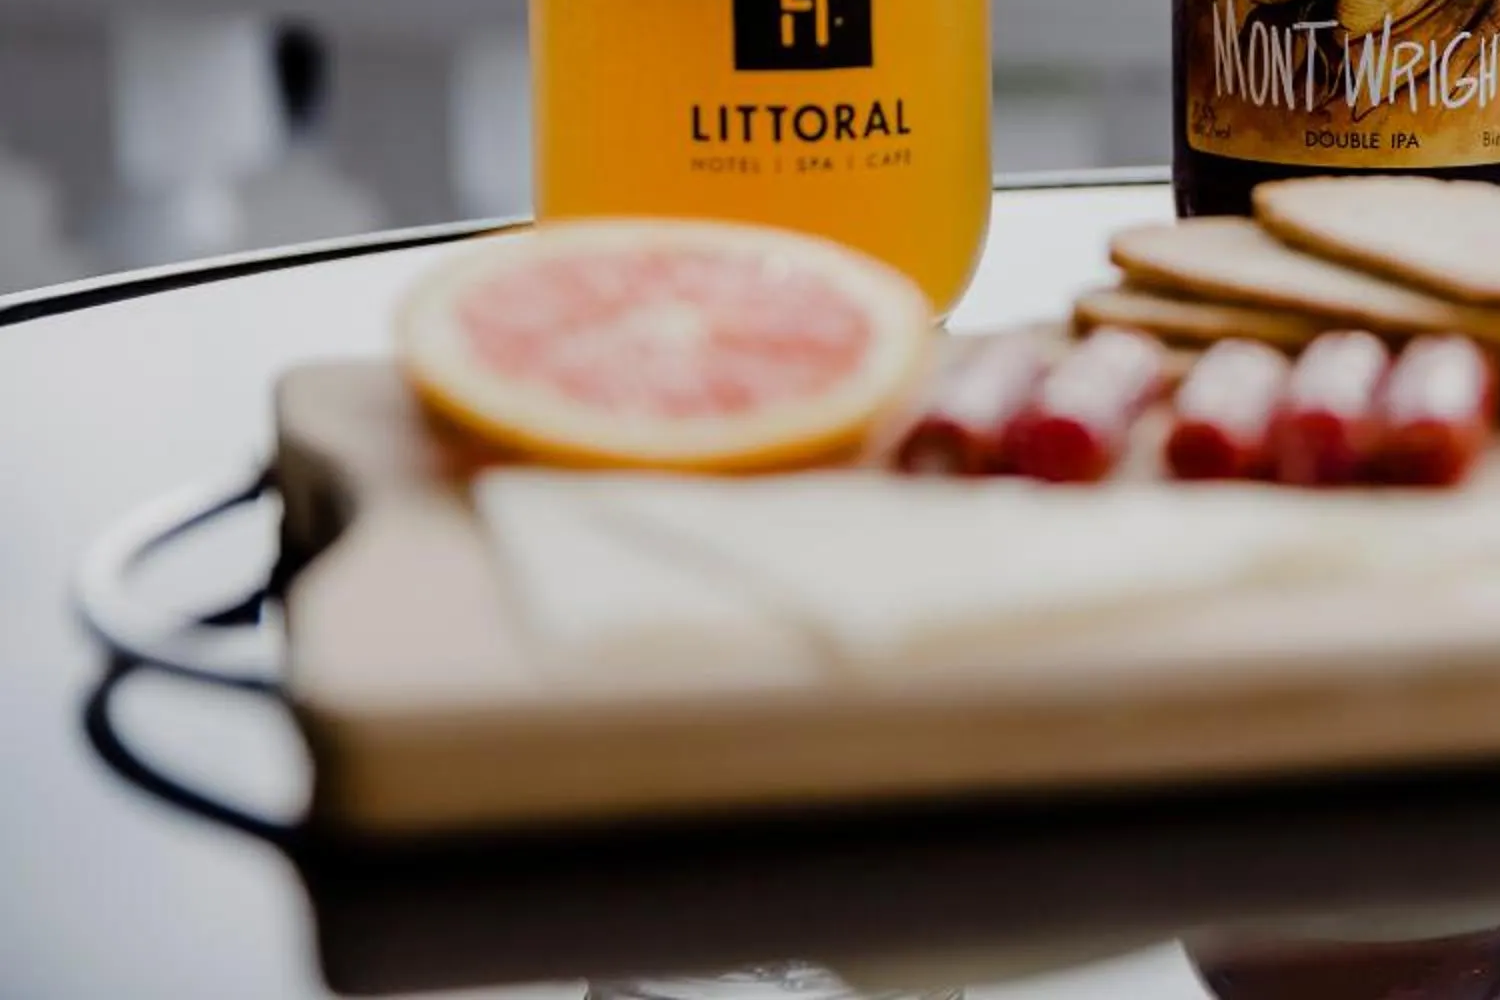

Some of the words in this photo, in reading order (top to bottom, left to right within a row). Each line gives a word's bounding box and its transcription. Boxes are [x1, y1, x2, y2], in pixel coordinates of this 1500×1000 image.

[690, 98, 911, 143] LITTORAL
[1304, 130, 1380, 149] DOUBLE
[1390, 131, 1420, 149] IPA
[796, 155, 834, 174] SPA
